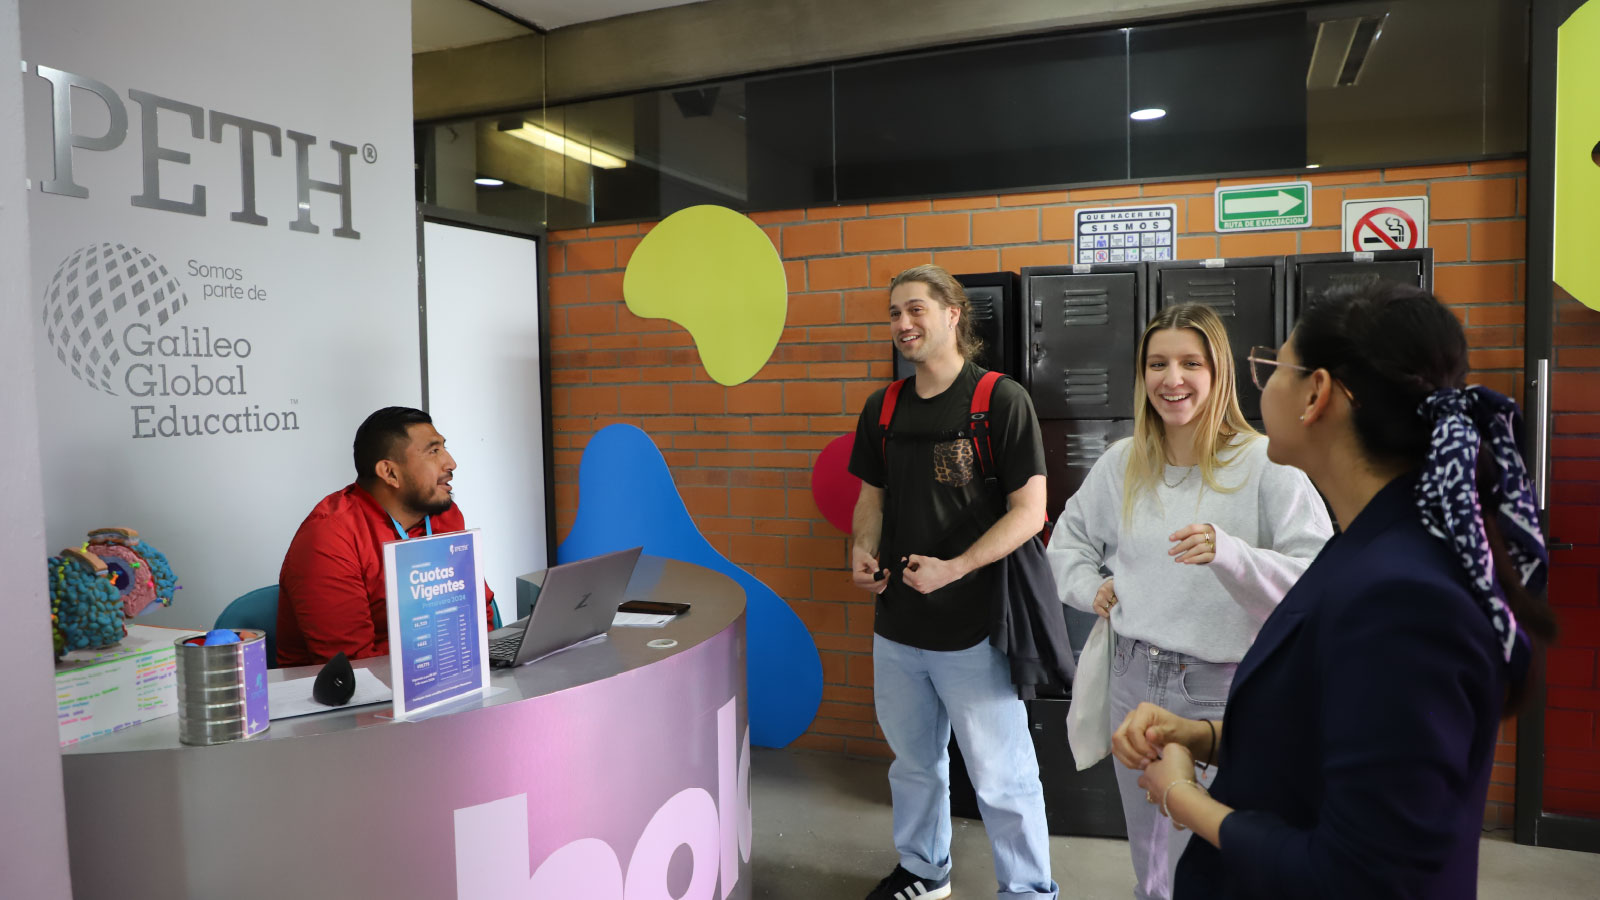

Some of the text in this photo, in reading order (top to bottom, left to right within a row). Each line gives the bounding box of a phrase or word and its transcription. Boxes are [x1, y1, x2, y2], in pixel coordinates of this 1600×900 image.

[1110, 211, 1143, 219] HACER
[1224, 221, 1243, 229] RUTA
[1091, 221, 1160, 232] SISMOS
[187, 259, 243, 281] Somos
[203, 281, 267, 302] parte de
[123, 322, 252, 359] Galileo
[125, 363, 247, 398] Global
[409, 566, 455, 585] Cuotas
[410, 579, 466, 601] Vigentes
